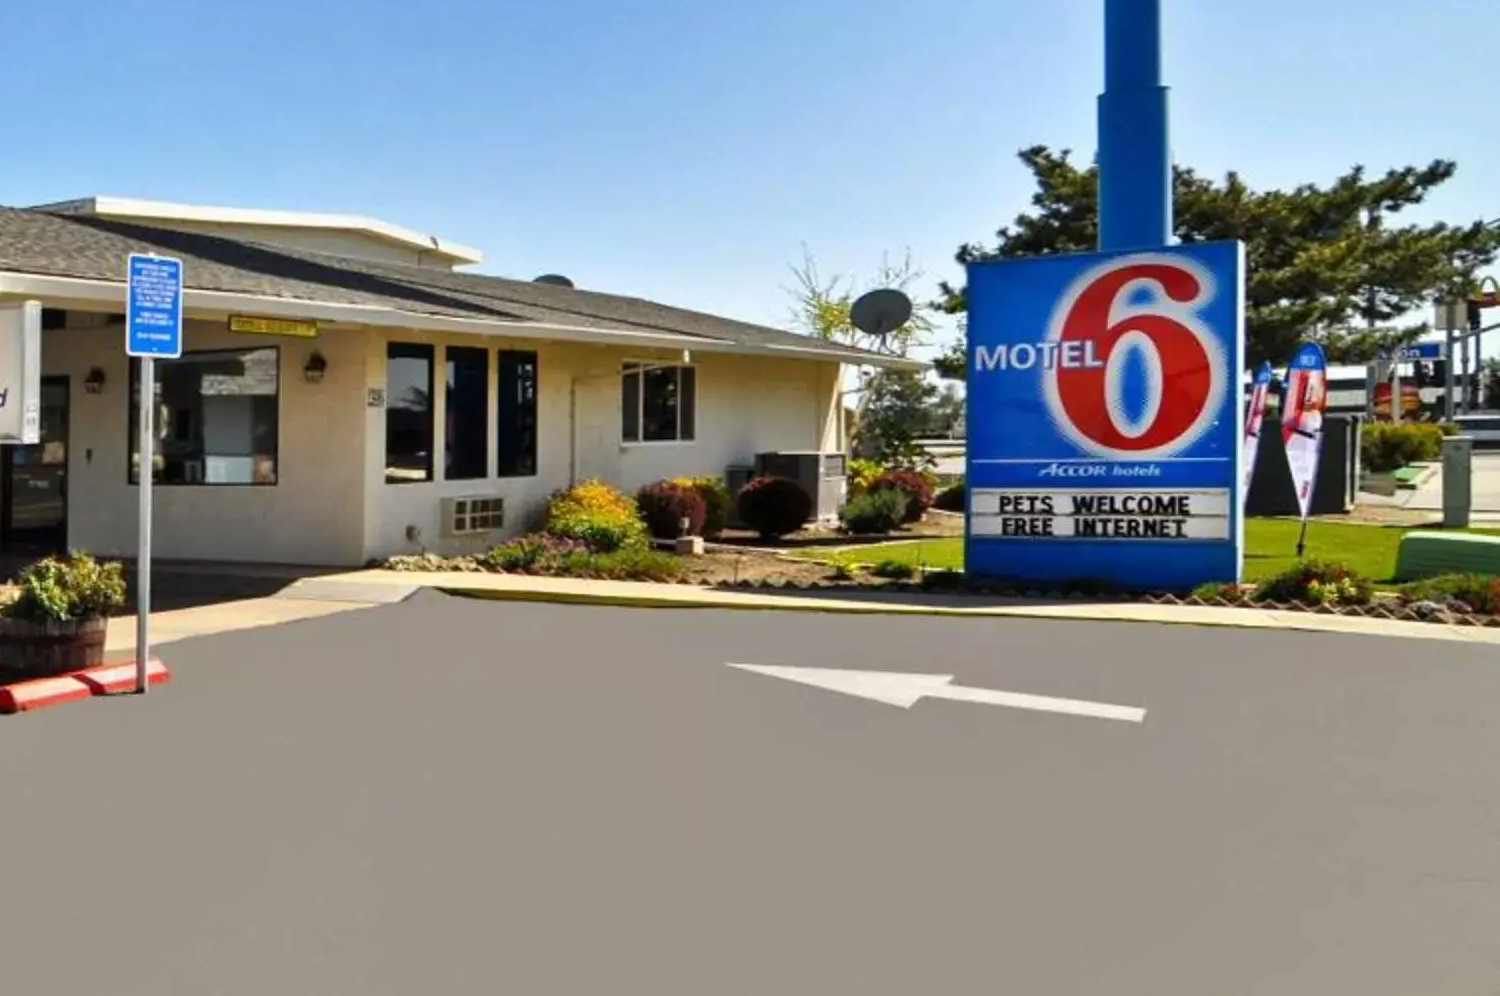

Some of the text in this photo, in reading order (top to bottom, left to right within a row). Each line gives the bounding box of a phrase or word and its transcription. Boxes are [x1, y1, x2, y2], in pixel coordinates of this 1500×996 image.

[974, 261, 1213, 453] MOTEL 6
[1111, 463, 1161, 477] hotels
[999, 495, 1191, 515] PETS WELCOME
[1001, 517, 1189, 538] FREE INTERNET
